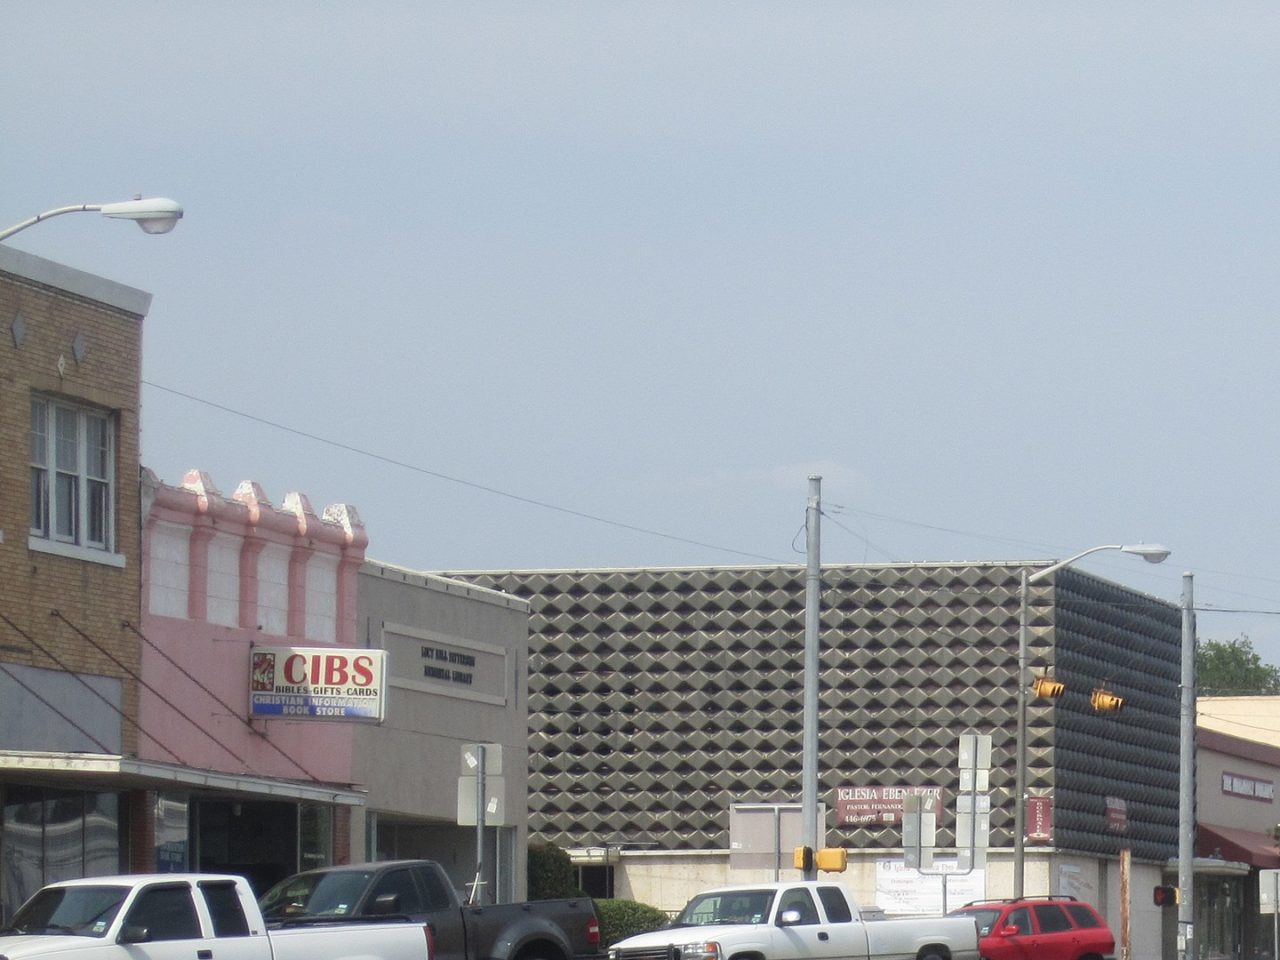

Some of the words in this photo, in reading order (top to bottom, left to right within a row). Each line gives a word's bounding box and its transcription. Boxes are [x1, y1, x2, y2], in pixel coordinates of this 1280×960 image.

[283, 653, 374, 687] CIBS
[275, 685, 308, 695] BIBLES
[313, 687, 341, 696] GIFTS
[346, 687, 378, 697] CARDS
[254, 694, 304, 706] CHRISTIAN
[283, 705, 309, 715] BOOK
[316, 706, 345, 716] STORE
[838, 788, 878, 801] IGLESIA
